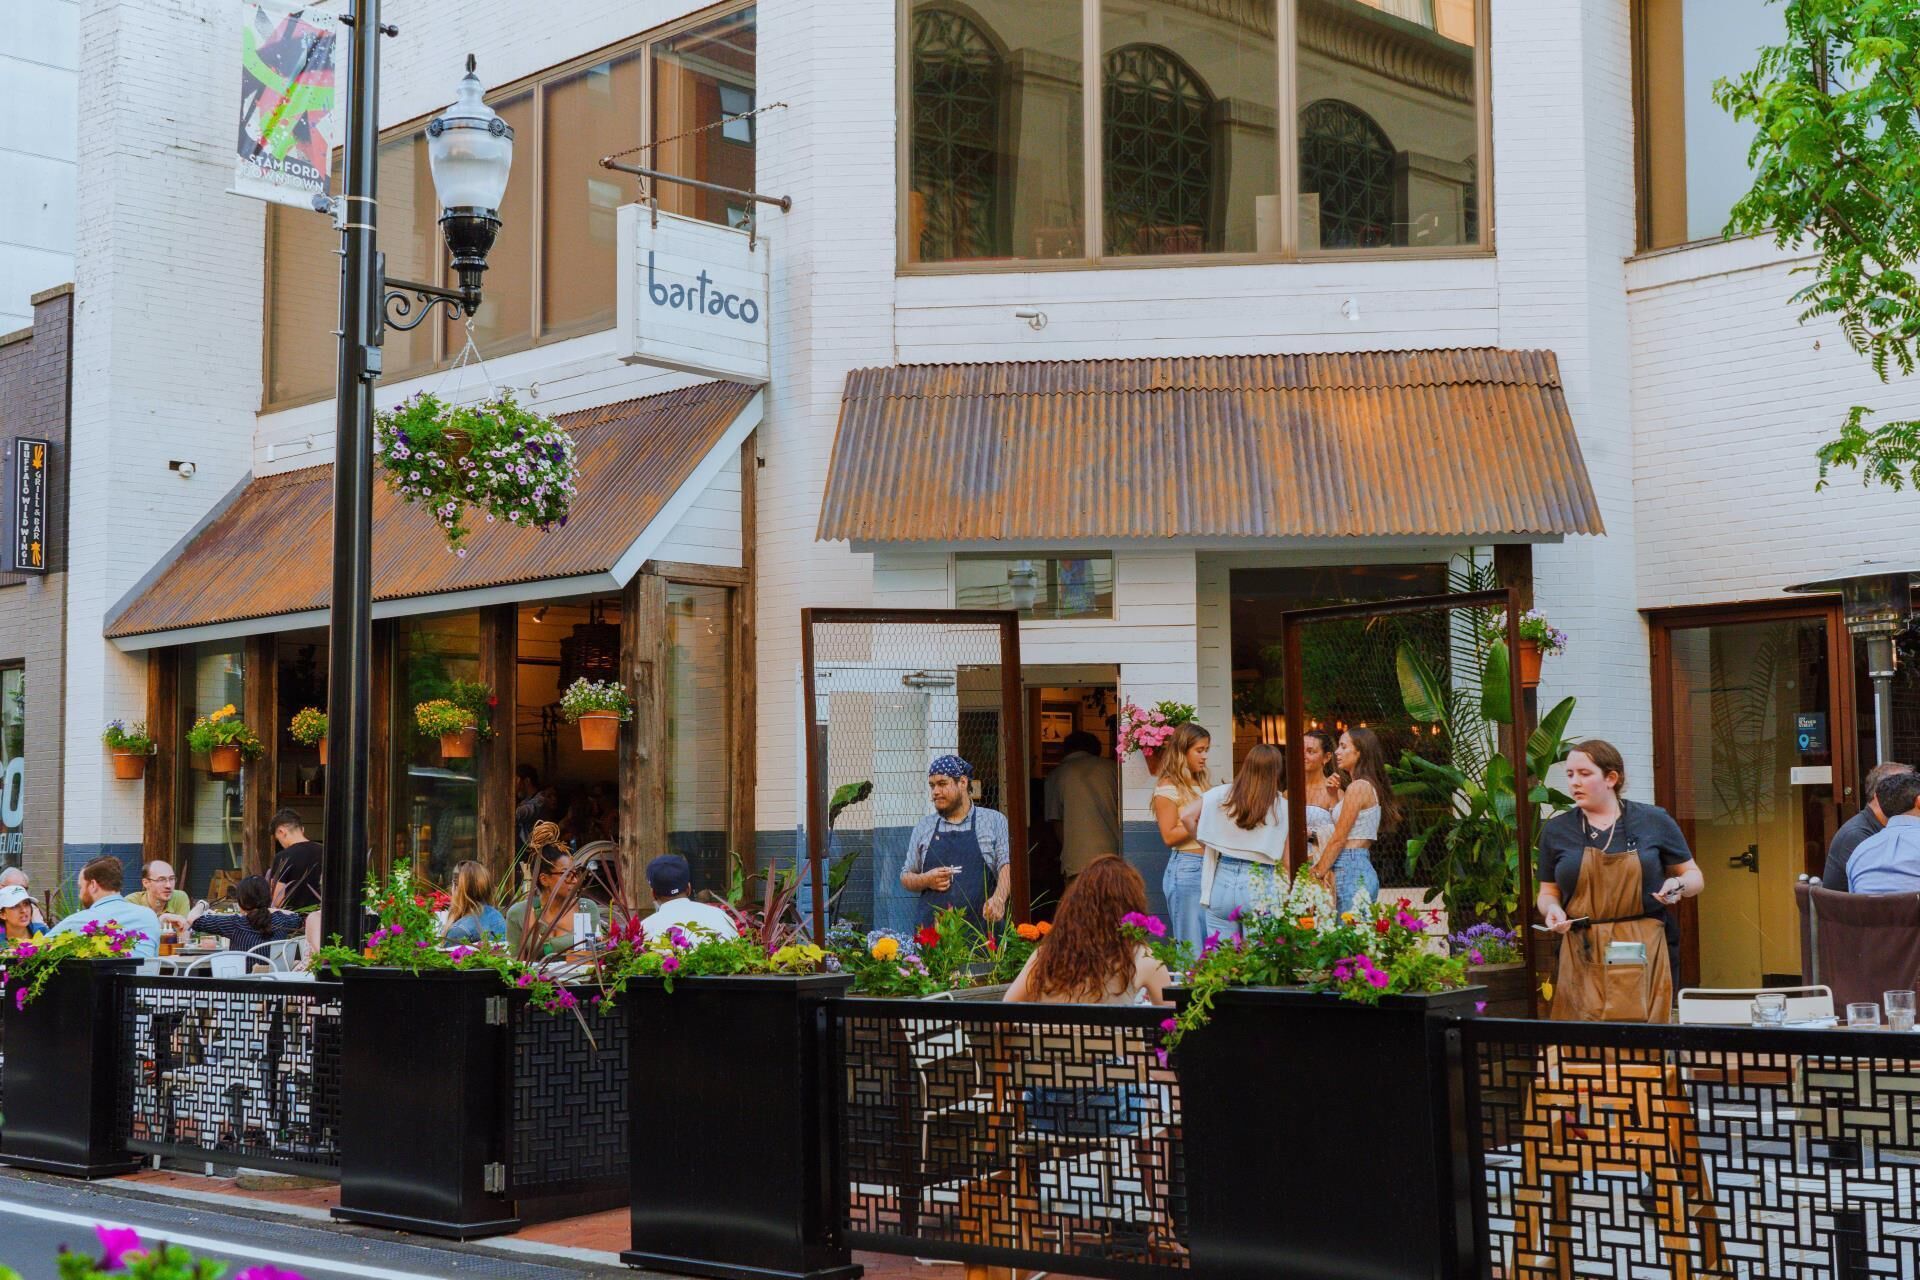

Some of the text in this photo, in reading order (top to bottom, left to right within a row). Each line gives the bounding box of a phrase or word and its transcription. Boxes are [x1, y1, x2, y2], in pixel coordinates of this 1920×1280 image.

[241, 165, 324, 192] DOWNTOWN
[249, 154, 320, 179] STAMFORD
[649, 251, 759, 324] bartaco
[22, 496, 30, 526] WILD
[20, 528, 29, 565] WINGS
